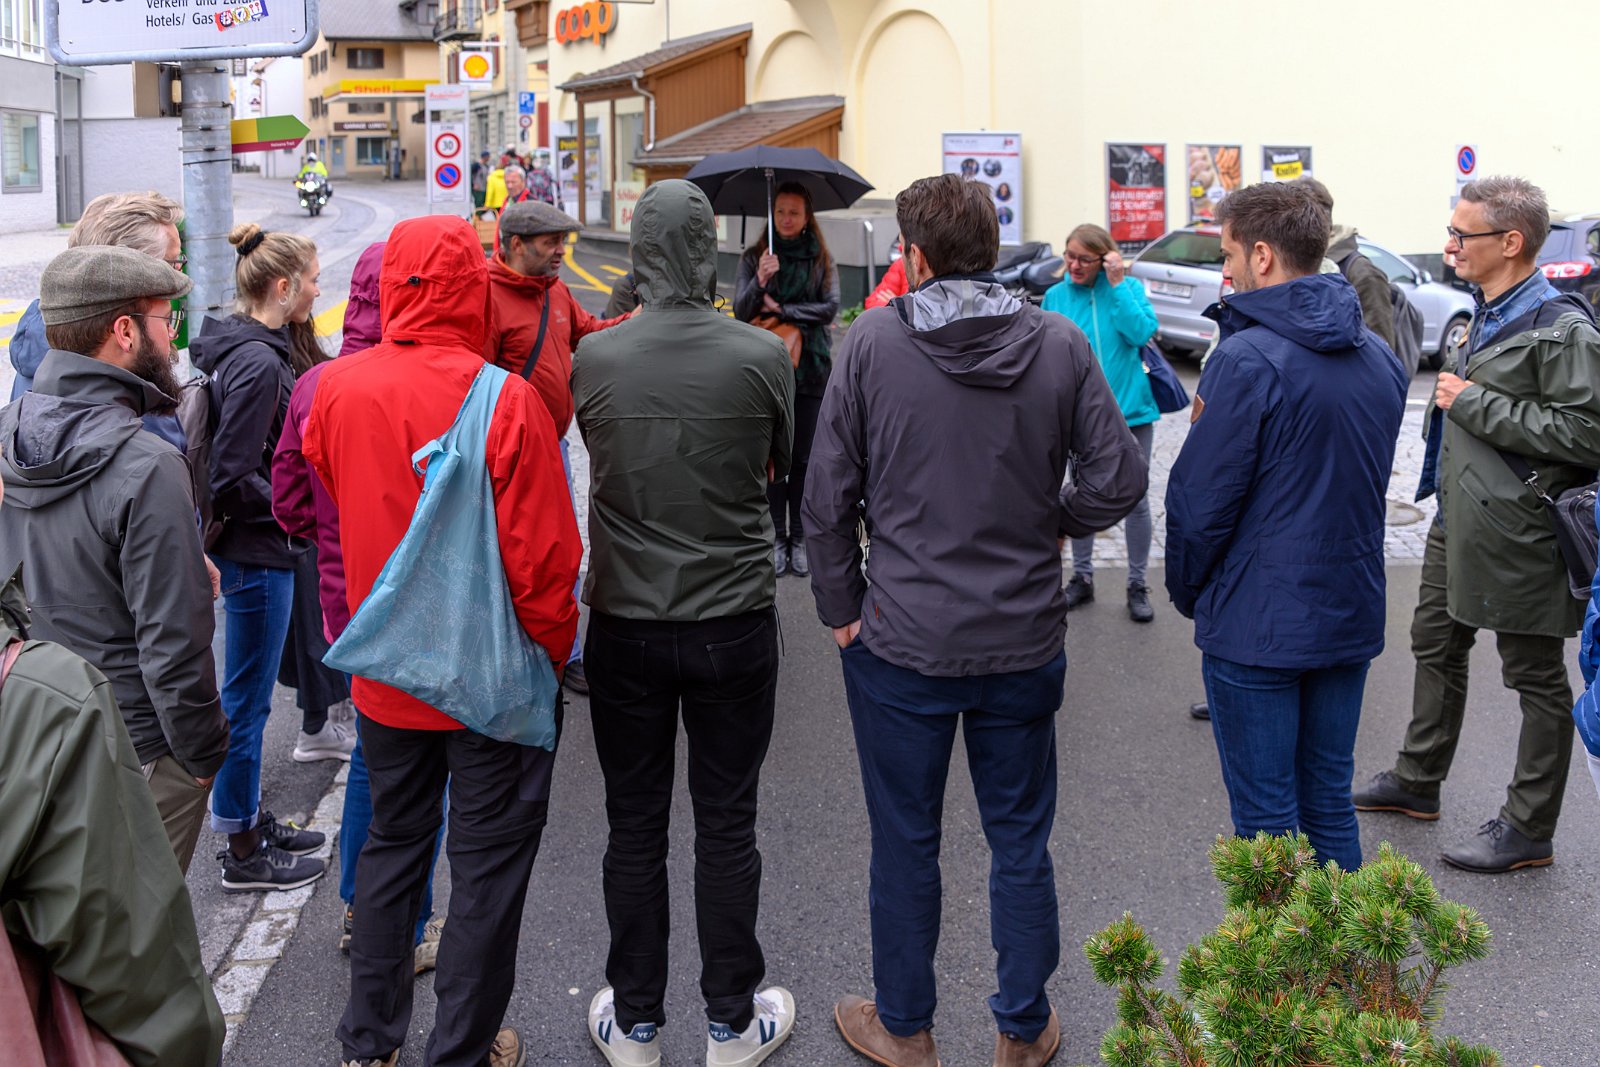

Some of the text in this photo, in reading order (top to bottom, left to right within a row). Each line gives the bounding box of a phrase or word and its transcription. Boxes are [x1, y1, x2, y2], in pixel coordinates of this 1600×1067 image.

[146, 13, 186, 28] Hotels/
[555, 1, 613, 46] coop
[442, 140, 455, 151] 30
